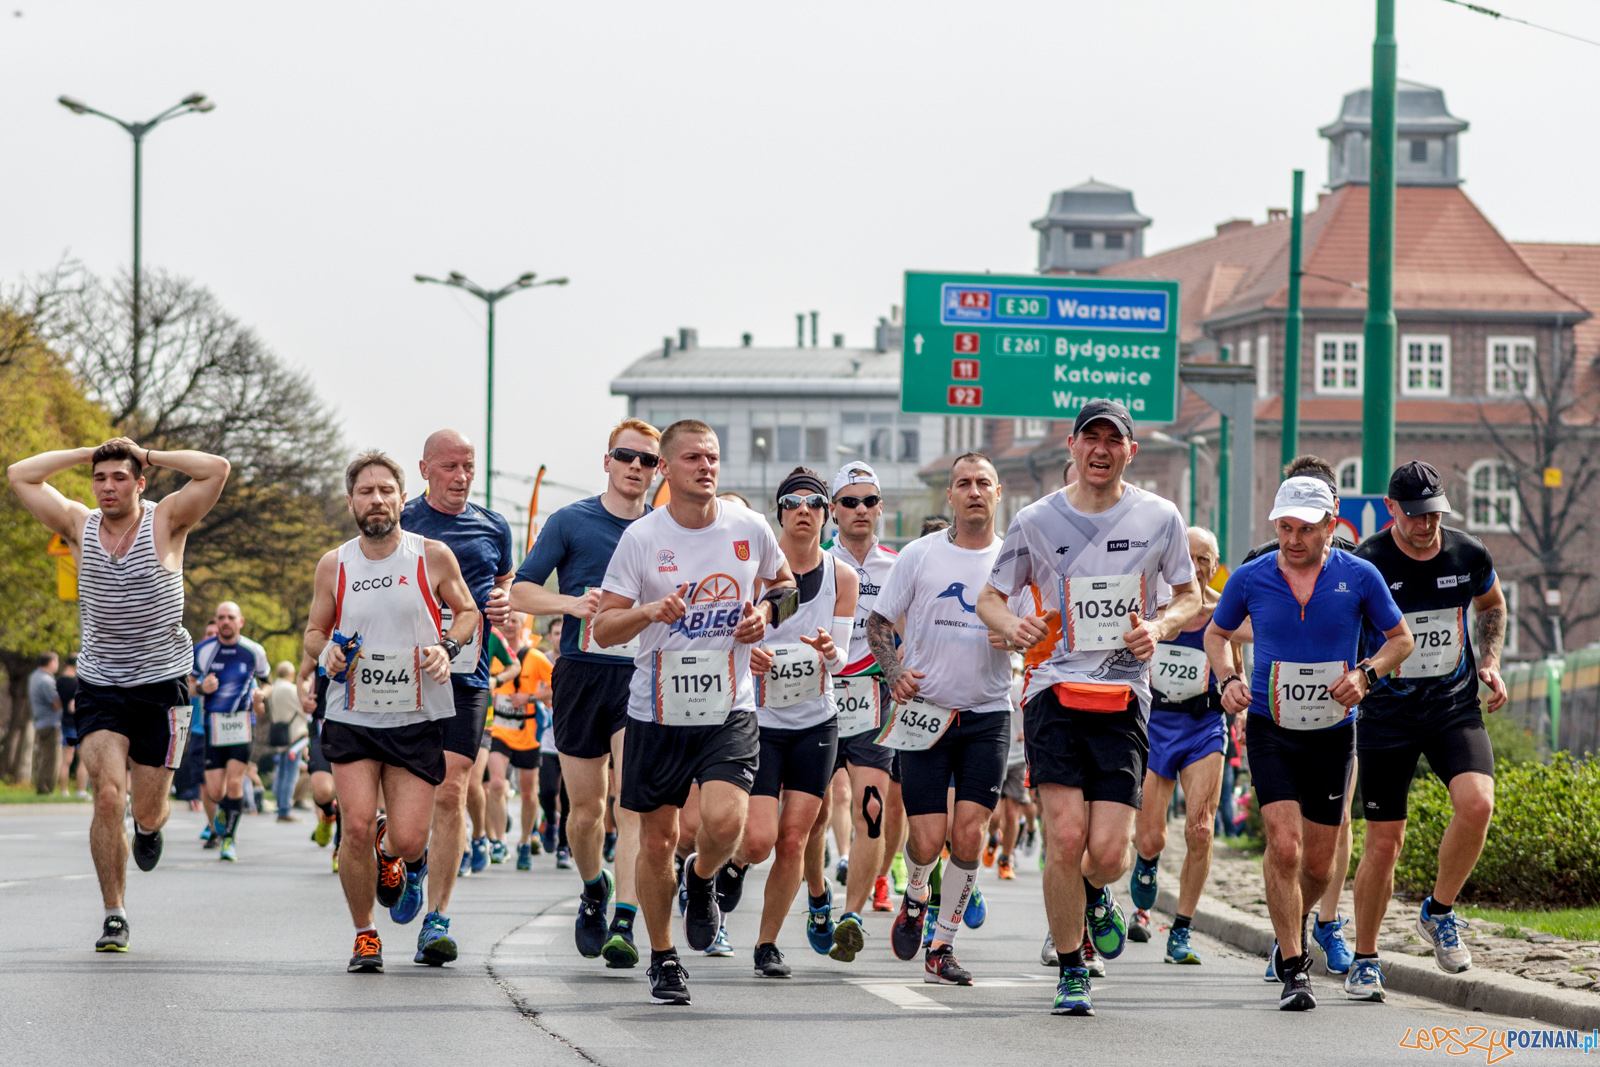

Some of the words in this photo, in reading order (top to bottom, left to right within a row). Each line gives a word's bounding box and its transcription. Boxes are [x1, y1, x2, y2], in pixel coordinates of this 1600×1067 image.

[964, 293, 986, 307] A2
[1006, 299, 1016, 314] E
[1018, 299, 1040, 315] 30
[1057, 298, 1161, 321] Warszawa
[1002, 337, 1012, 353] E
[1015, 337, 1041, 353] 261
[1055, 337, 1161, 362] Bydgoszcz
[959, 362, 973, 377] 11
[1054, 364, 1152, 385] Katowice
[954, 387, 976, 404] 92
[1052, 390, 1145, 412] Wrznia
[352, 576, 393, 592] ecco
[676, 582, 698, 599] 7
[1075, 598, 1140, 619] 10364
[690, 609, 741, 631] BIEG
[934, 619, 969, 628] WRONIECKI
[361, 668, 411, 686] 8944
[1159, 662, 1199, 681] 7928
[671, 674, 722, 694] 11191
[1282, 684, 1338, 702] 1072
[1300, 704, 1326, 712] zbigniew
[221, 720, 245, 731] 1099
[900, 709, 941, 734] 4348
